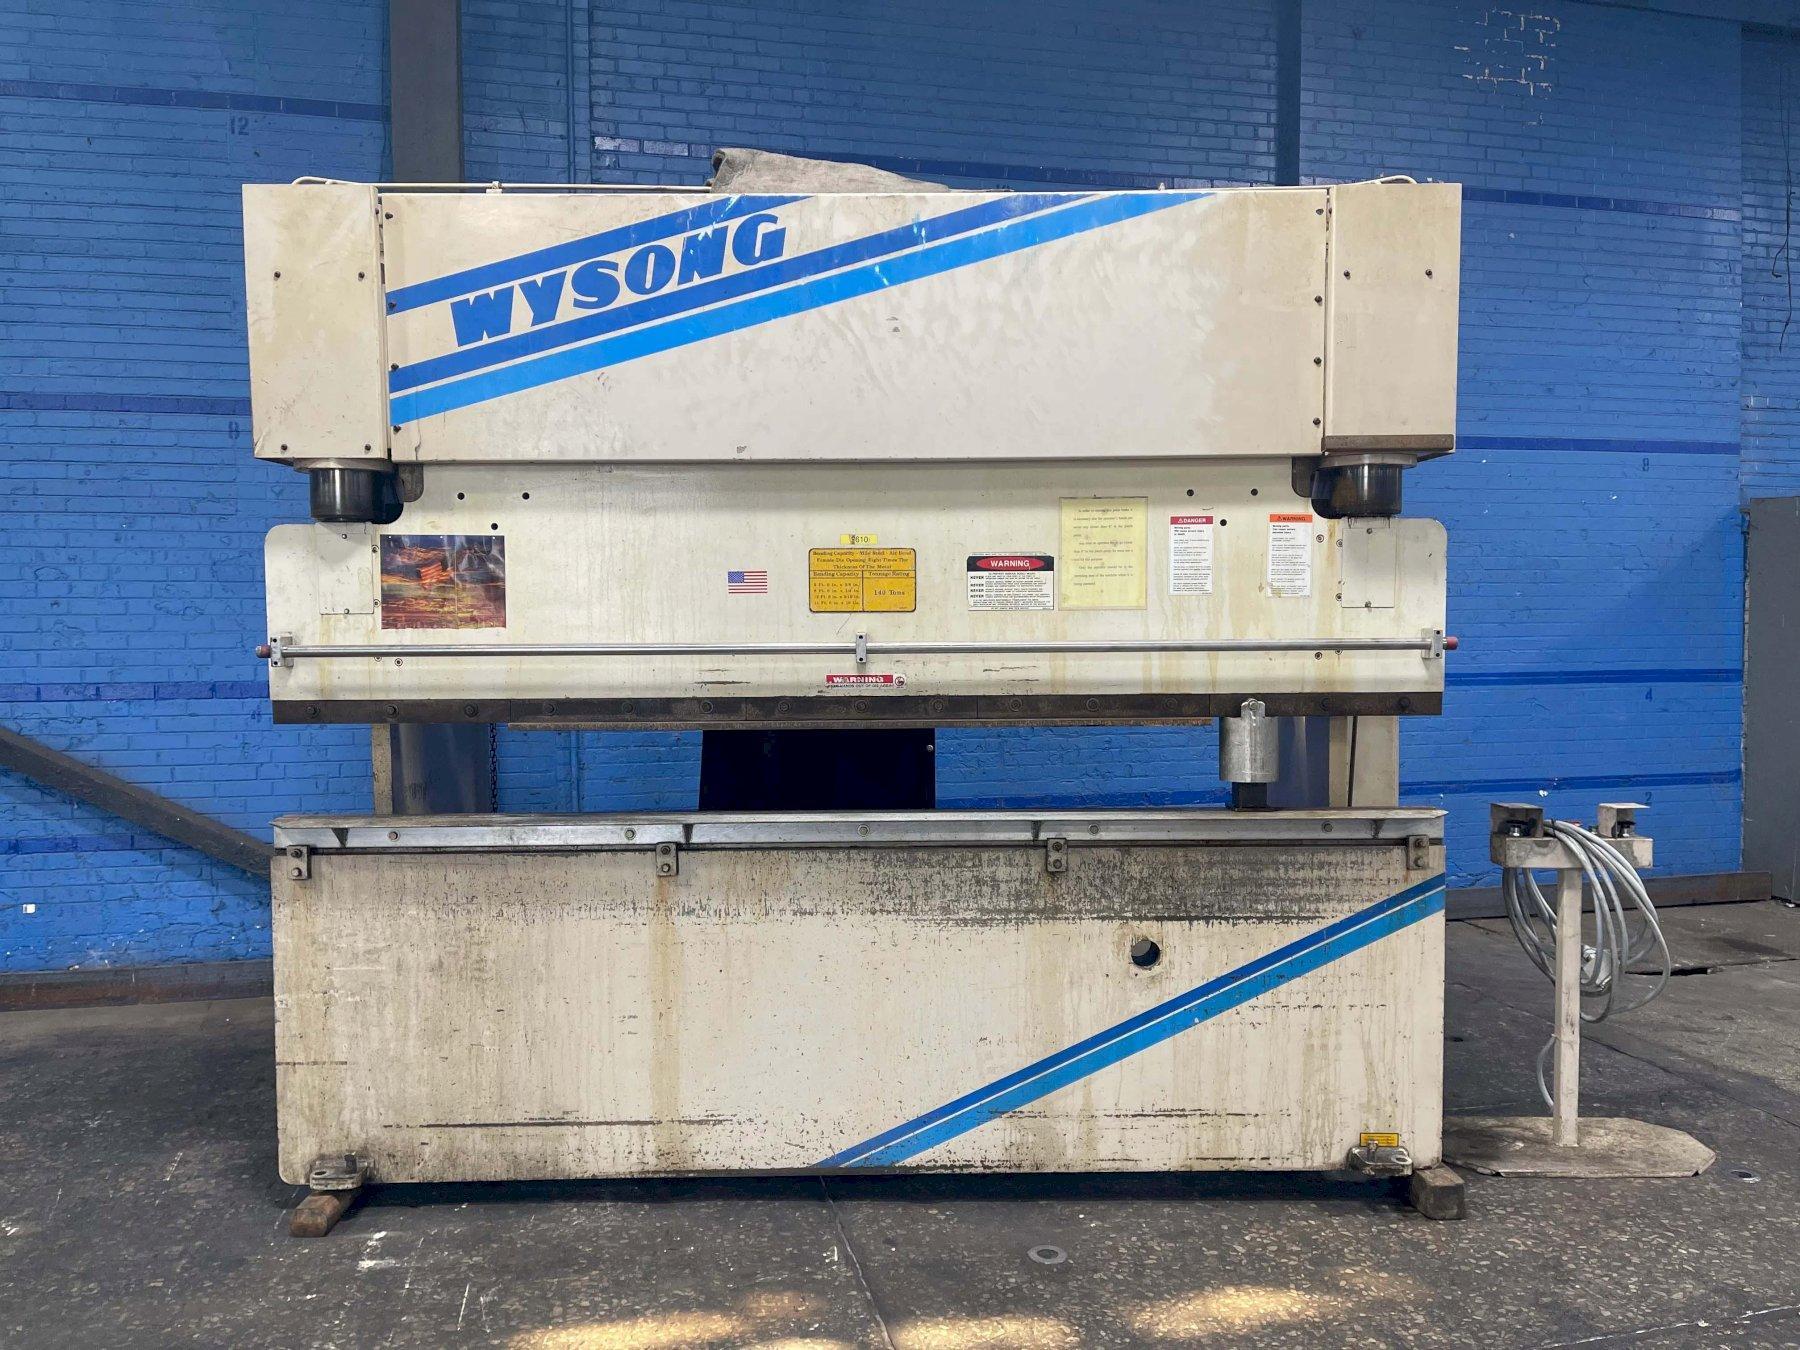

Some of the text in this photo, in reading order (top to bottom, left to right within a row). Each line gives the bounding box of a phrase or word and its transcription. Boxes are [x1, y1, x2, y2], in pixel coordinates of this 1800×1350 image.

[230, 115, 250, 136] 12
[450, 213, 786, 348] WYSONG
[1642, 458, 1649, 471] 8
[1645, 687, 1652, 702] 4
[1645, 791, 1652, 806] 2
